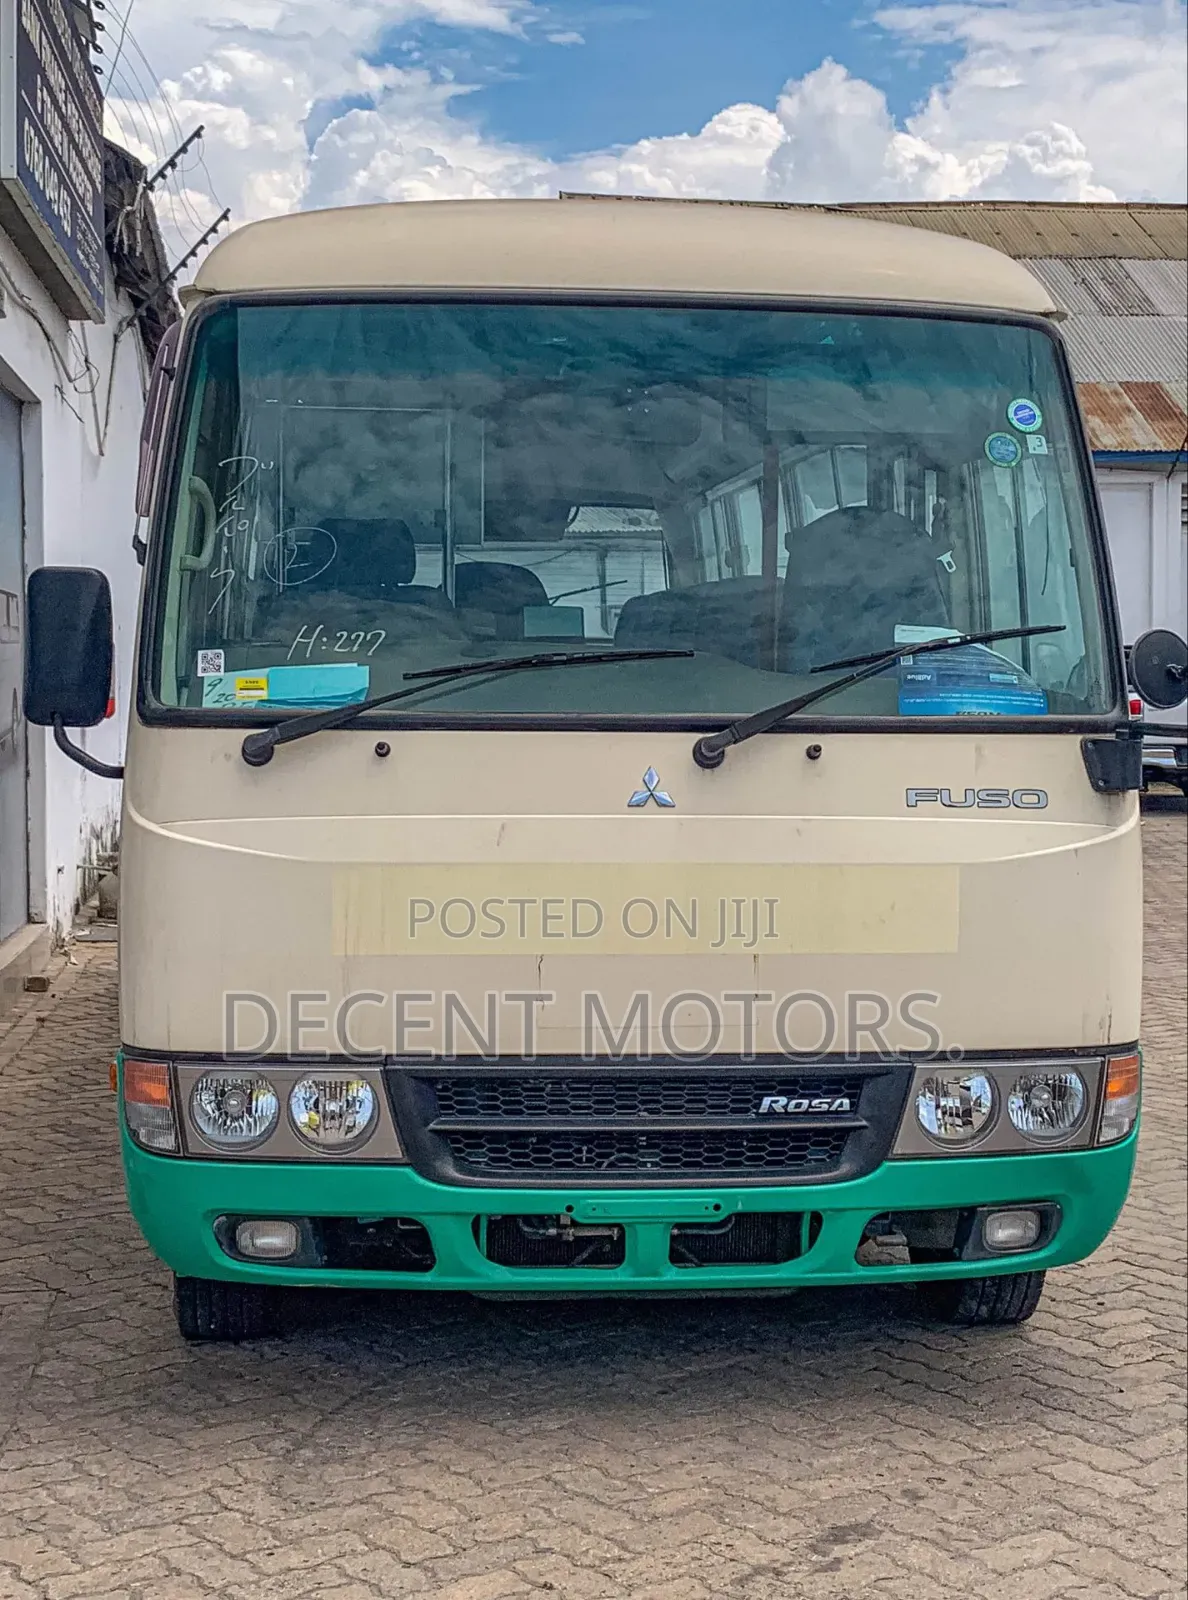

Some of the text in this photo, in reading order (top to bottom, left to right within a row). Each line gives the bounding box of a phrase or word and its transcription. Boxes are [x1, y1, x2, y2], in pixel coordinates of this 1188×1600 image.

[906, 673, 932, 681] AdBlue
[905, 788, 1049, 809] FUSO
[757, 1096, 853, 1114] ROSA
